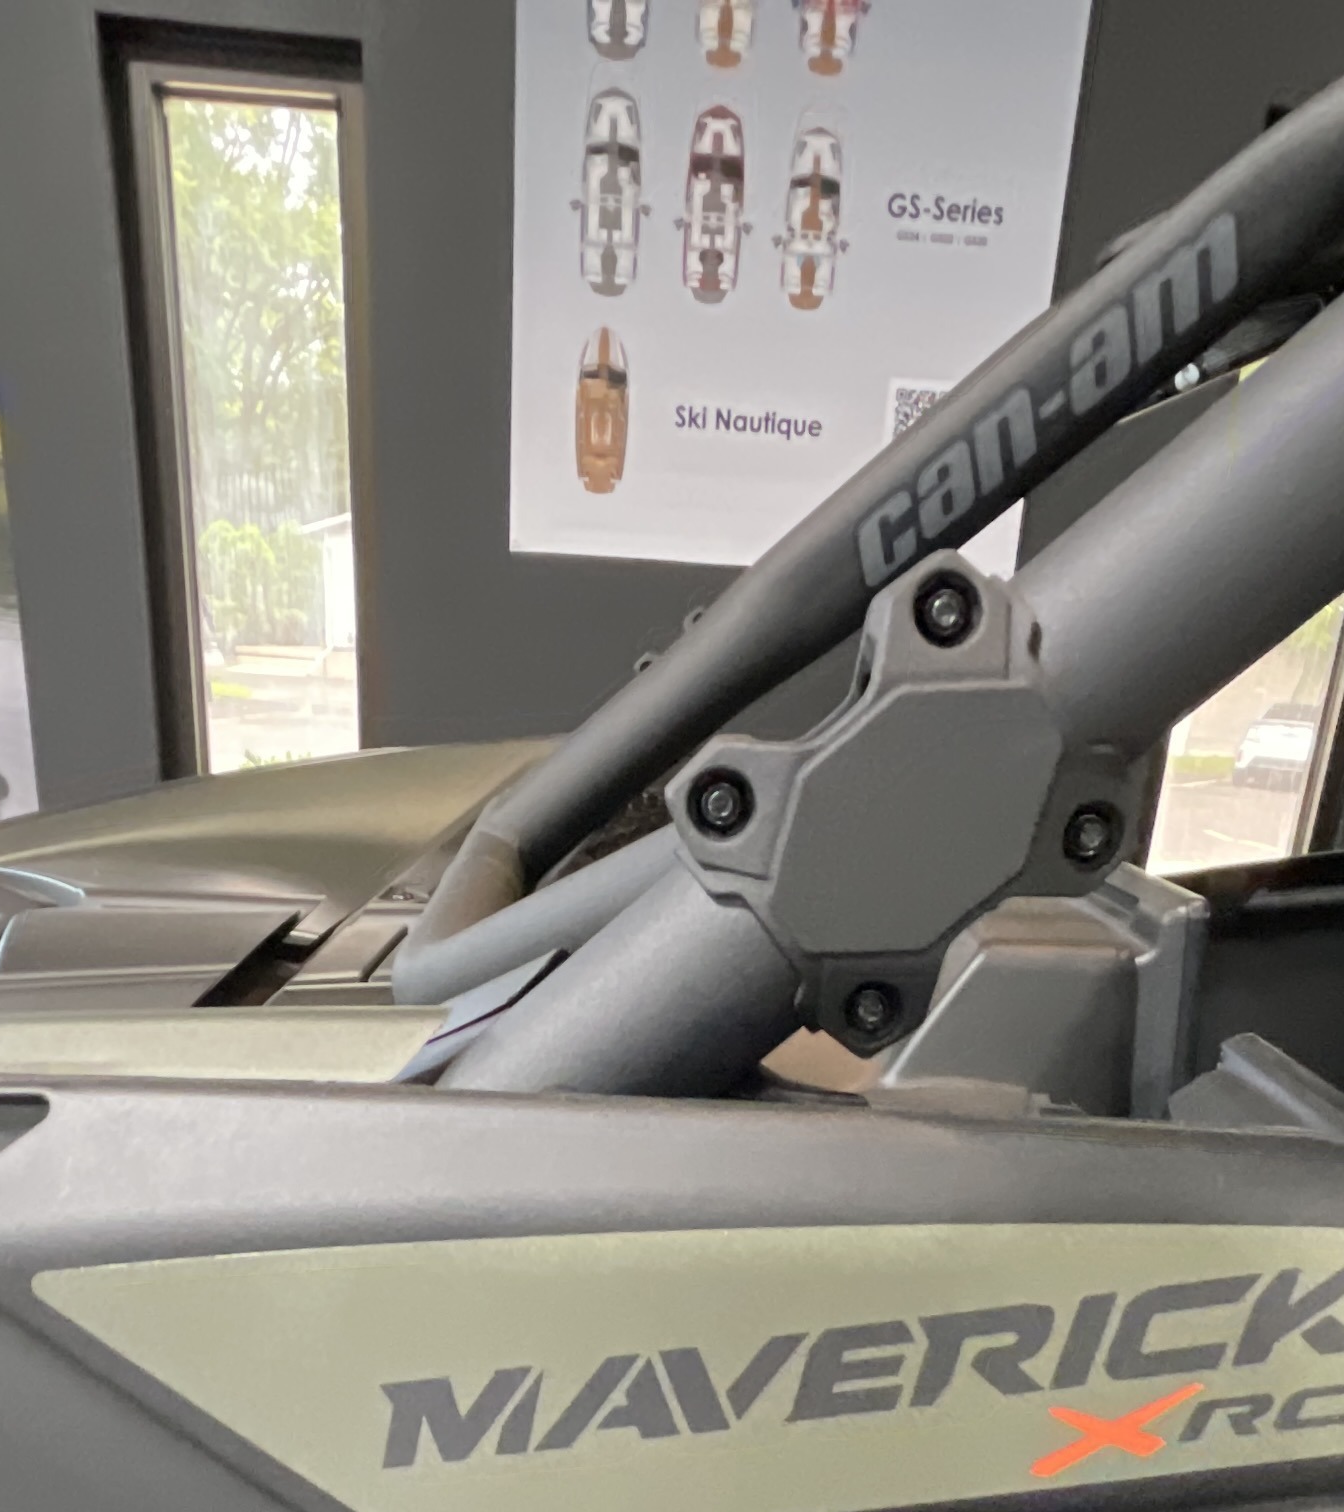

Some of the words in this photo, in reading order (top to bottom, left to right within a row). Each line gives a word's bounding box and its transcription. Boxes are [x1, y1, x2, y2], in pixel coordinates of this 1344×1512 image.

[887, 192, 1004, 226] GS-Series
[858, 212, 1239, 588] can-am
[674, 404, 707, 430] Ski
[715, 407, 823, 441] Nautique
